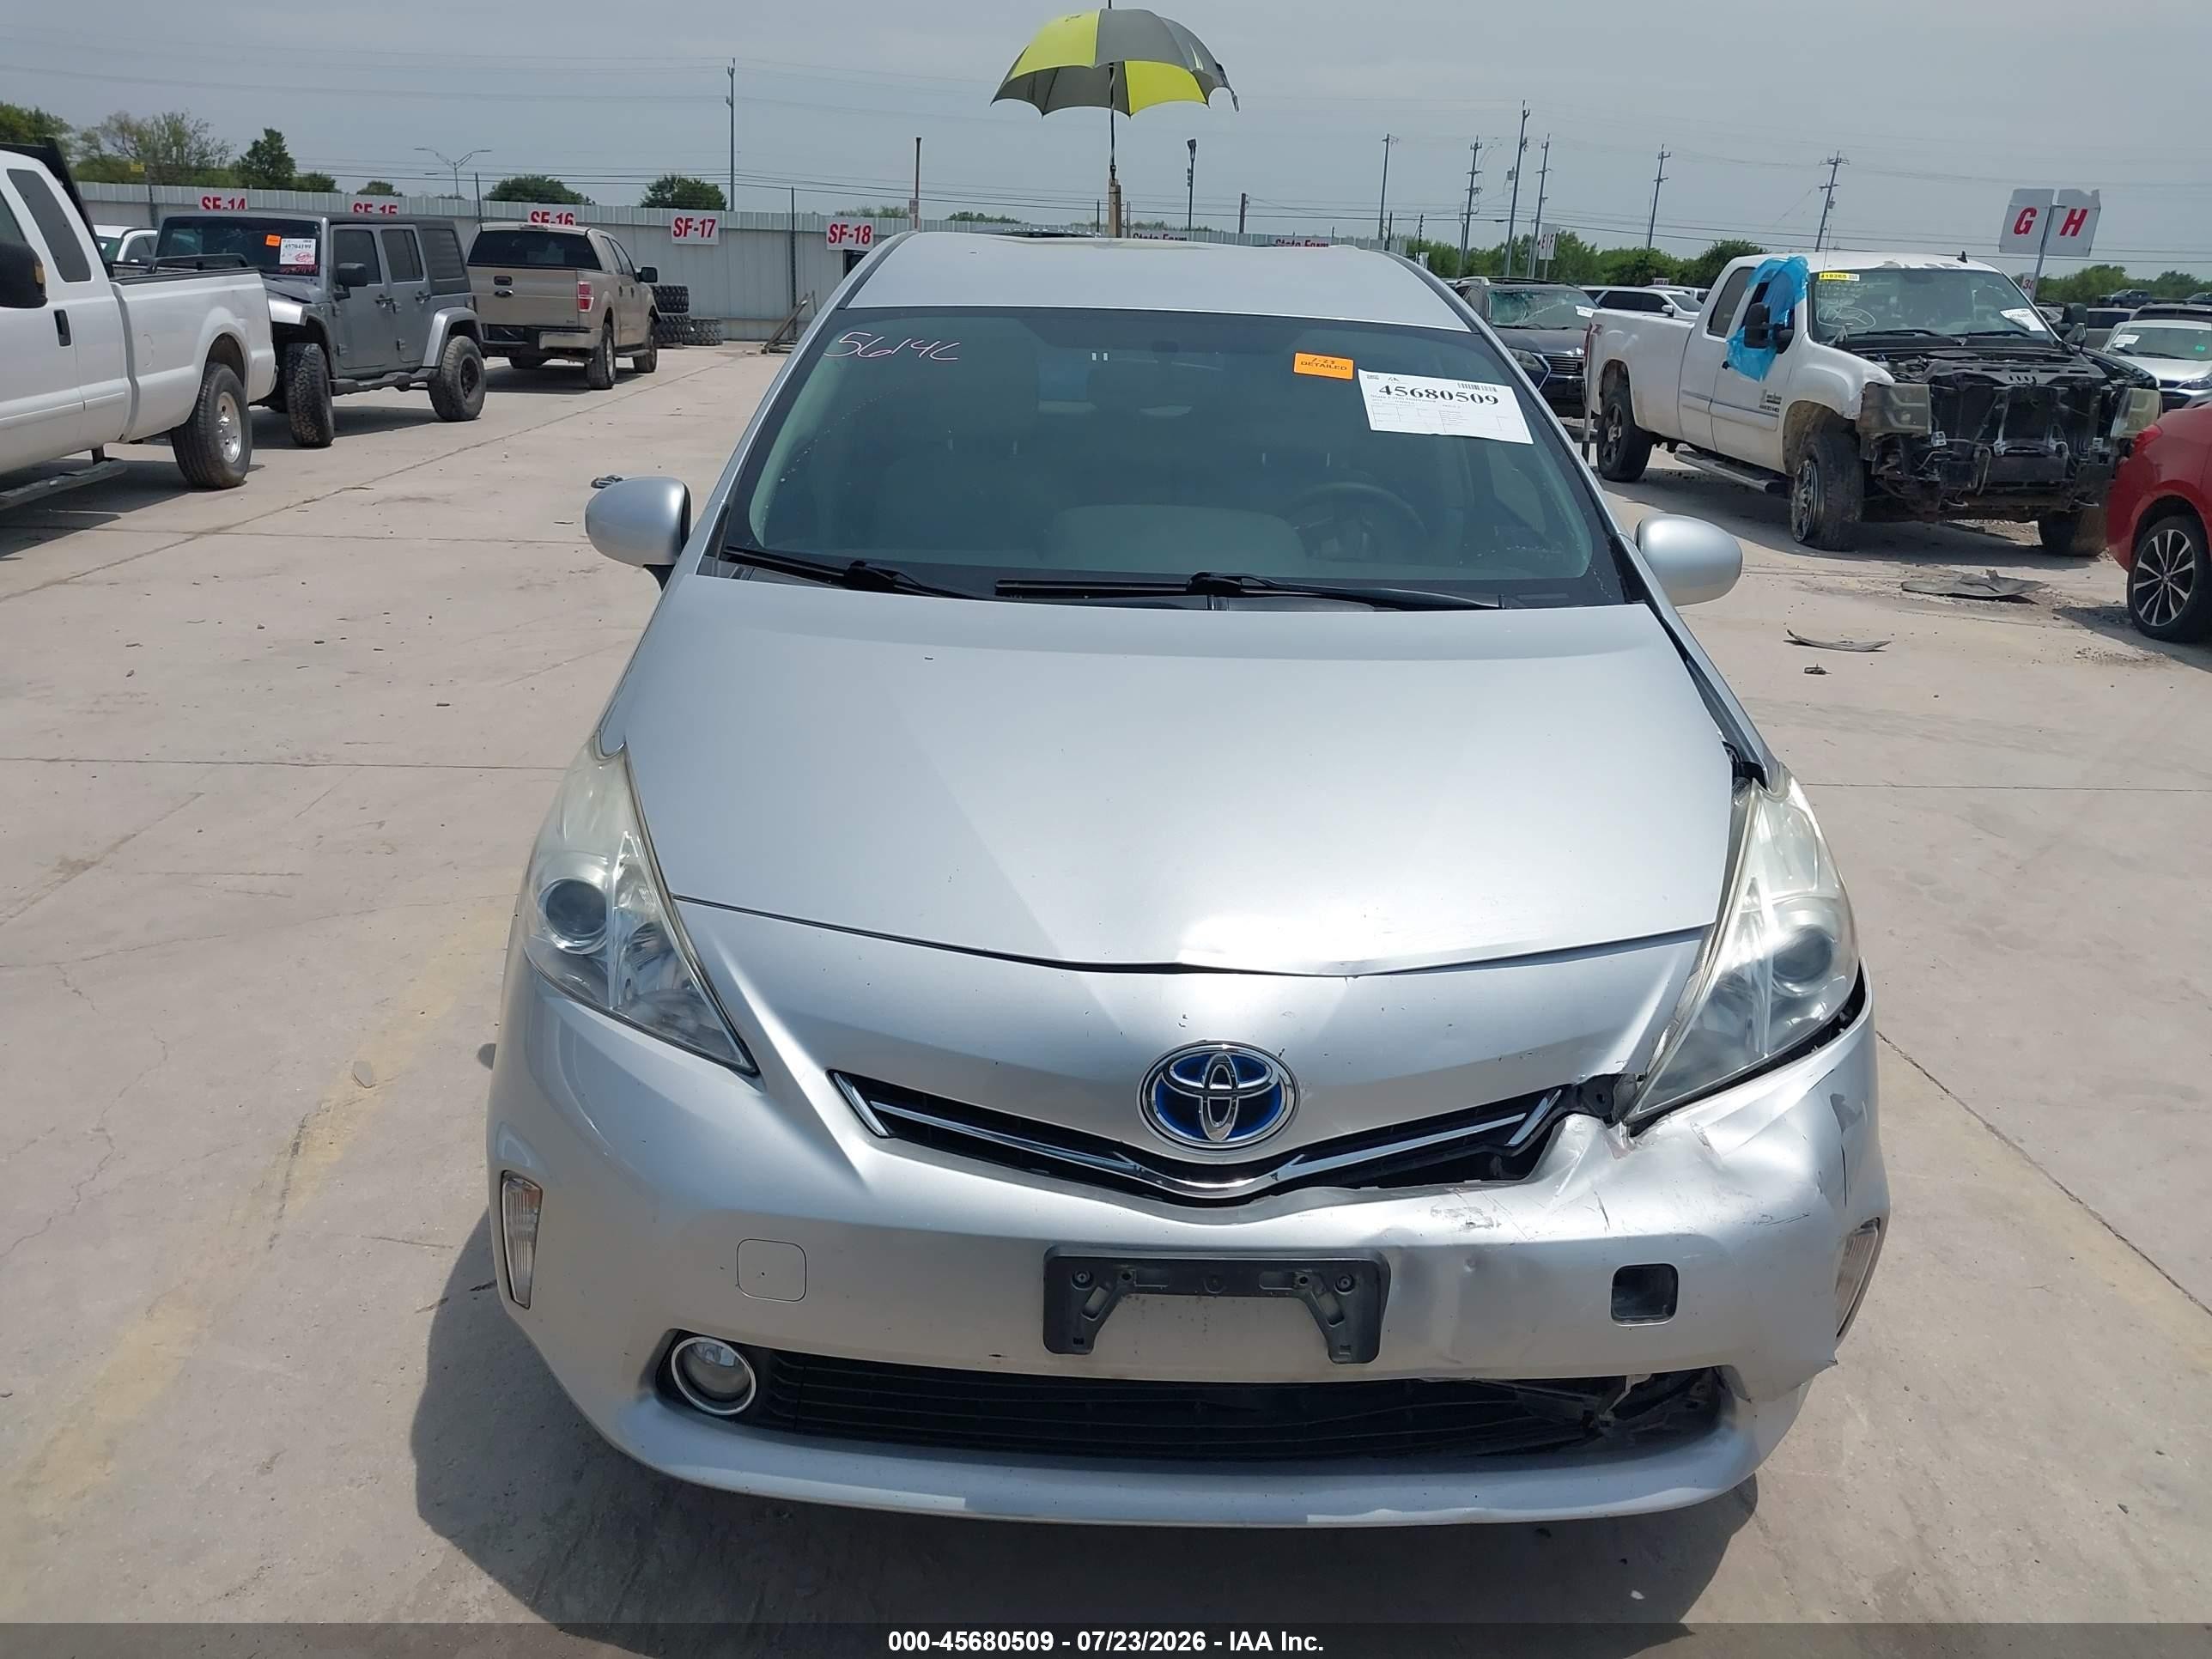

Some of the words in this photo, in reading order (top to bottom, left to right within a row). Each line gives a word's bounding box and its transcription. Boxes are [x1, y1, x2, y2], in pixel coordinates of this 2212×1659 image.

[530, 210, 574, 226] SF-16
[673, 216, 716, 238] SF-17
[2013, 207, 2038, 235] G
[2059, 208, 2088, 236] H
[828, 223, 872, 245] SF-18
[1300, 361, 1347, 371] DETAILED
[1378, 384, 1499, 406] 45680509
